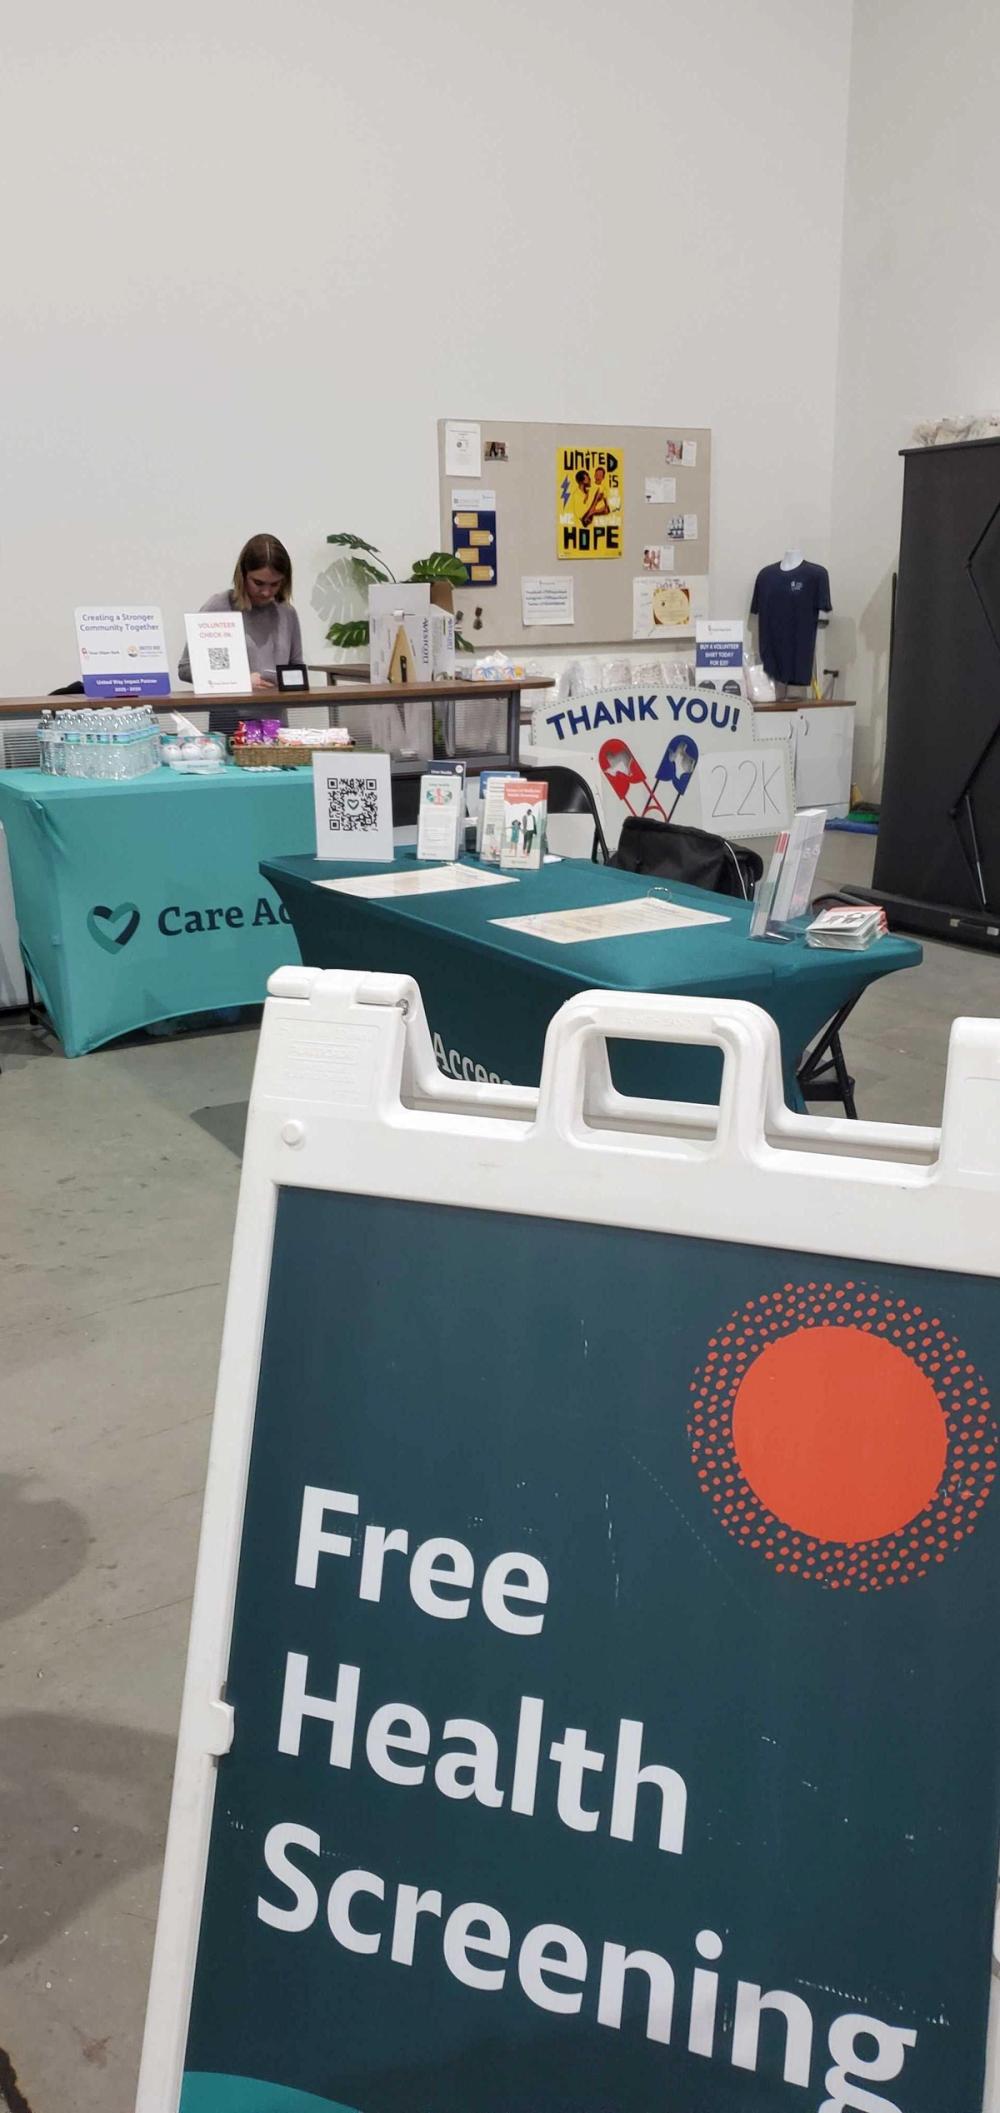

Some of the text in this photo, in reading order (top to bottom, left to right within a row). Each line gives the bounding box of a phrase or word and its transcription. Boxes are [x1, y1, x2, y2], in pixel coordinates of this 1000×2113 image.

[563, 526, 619, 551] HOPE
[80, 623, 159, 633] Community Together
[82, 614, 114, 622] Creating
[122, 613, 154, 622] Stronger
[546, 695, 740, 741] THANK YOU!
[711, 759, 781, 818] 22K
[158, 906, 244, 936] Care
[433, 1032, 512, 1085] Acce
[294, 1485, 550, 1636] Free
[278, 1651, 687, 1856] Health
[257, 1822, 917, 2113] Screening
